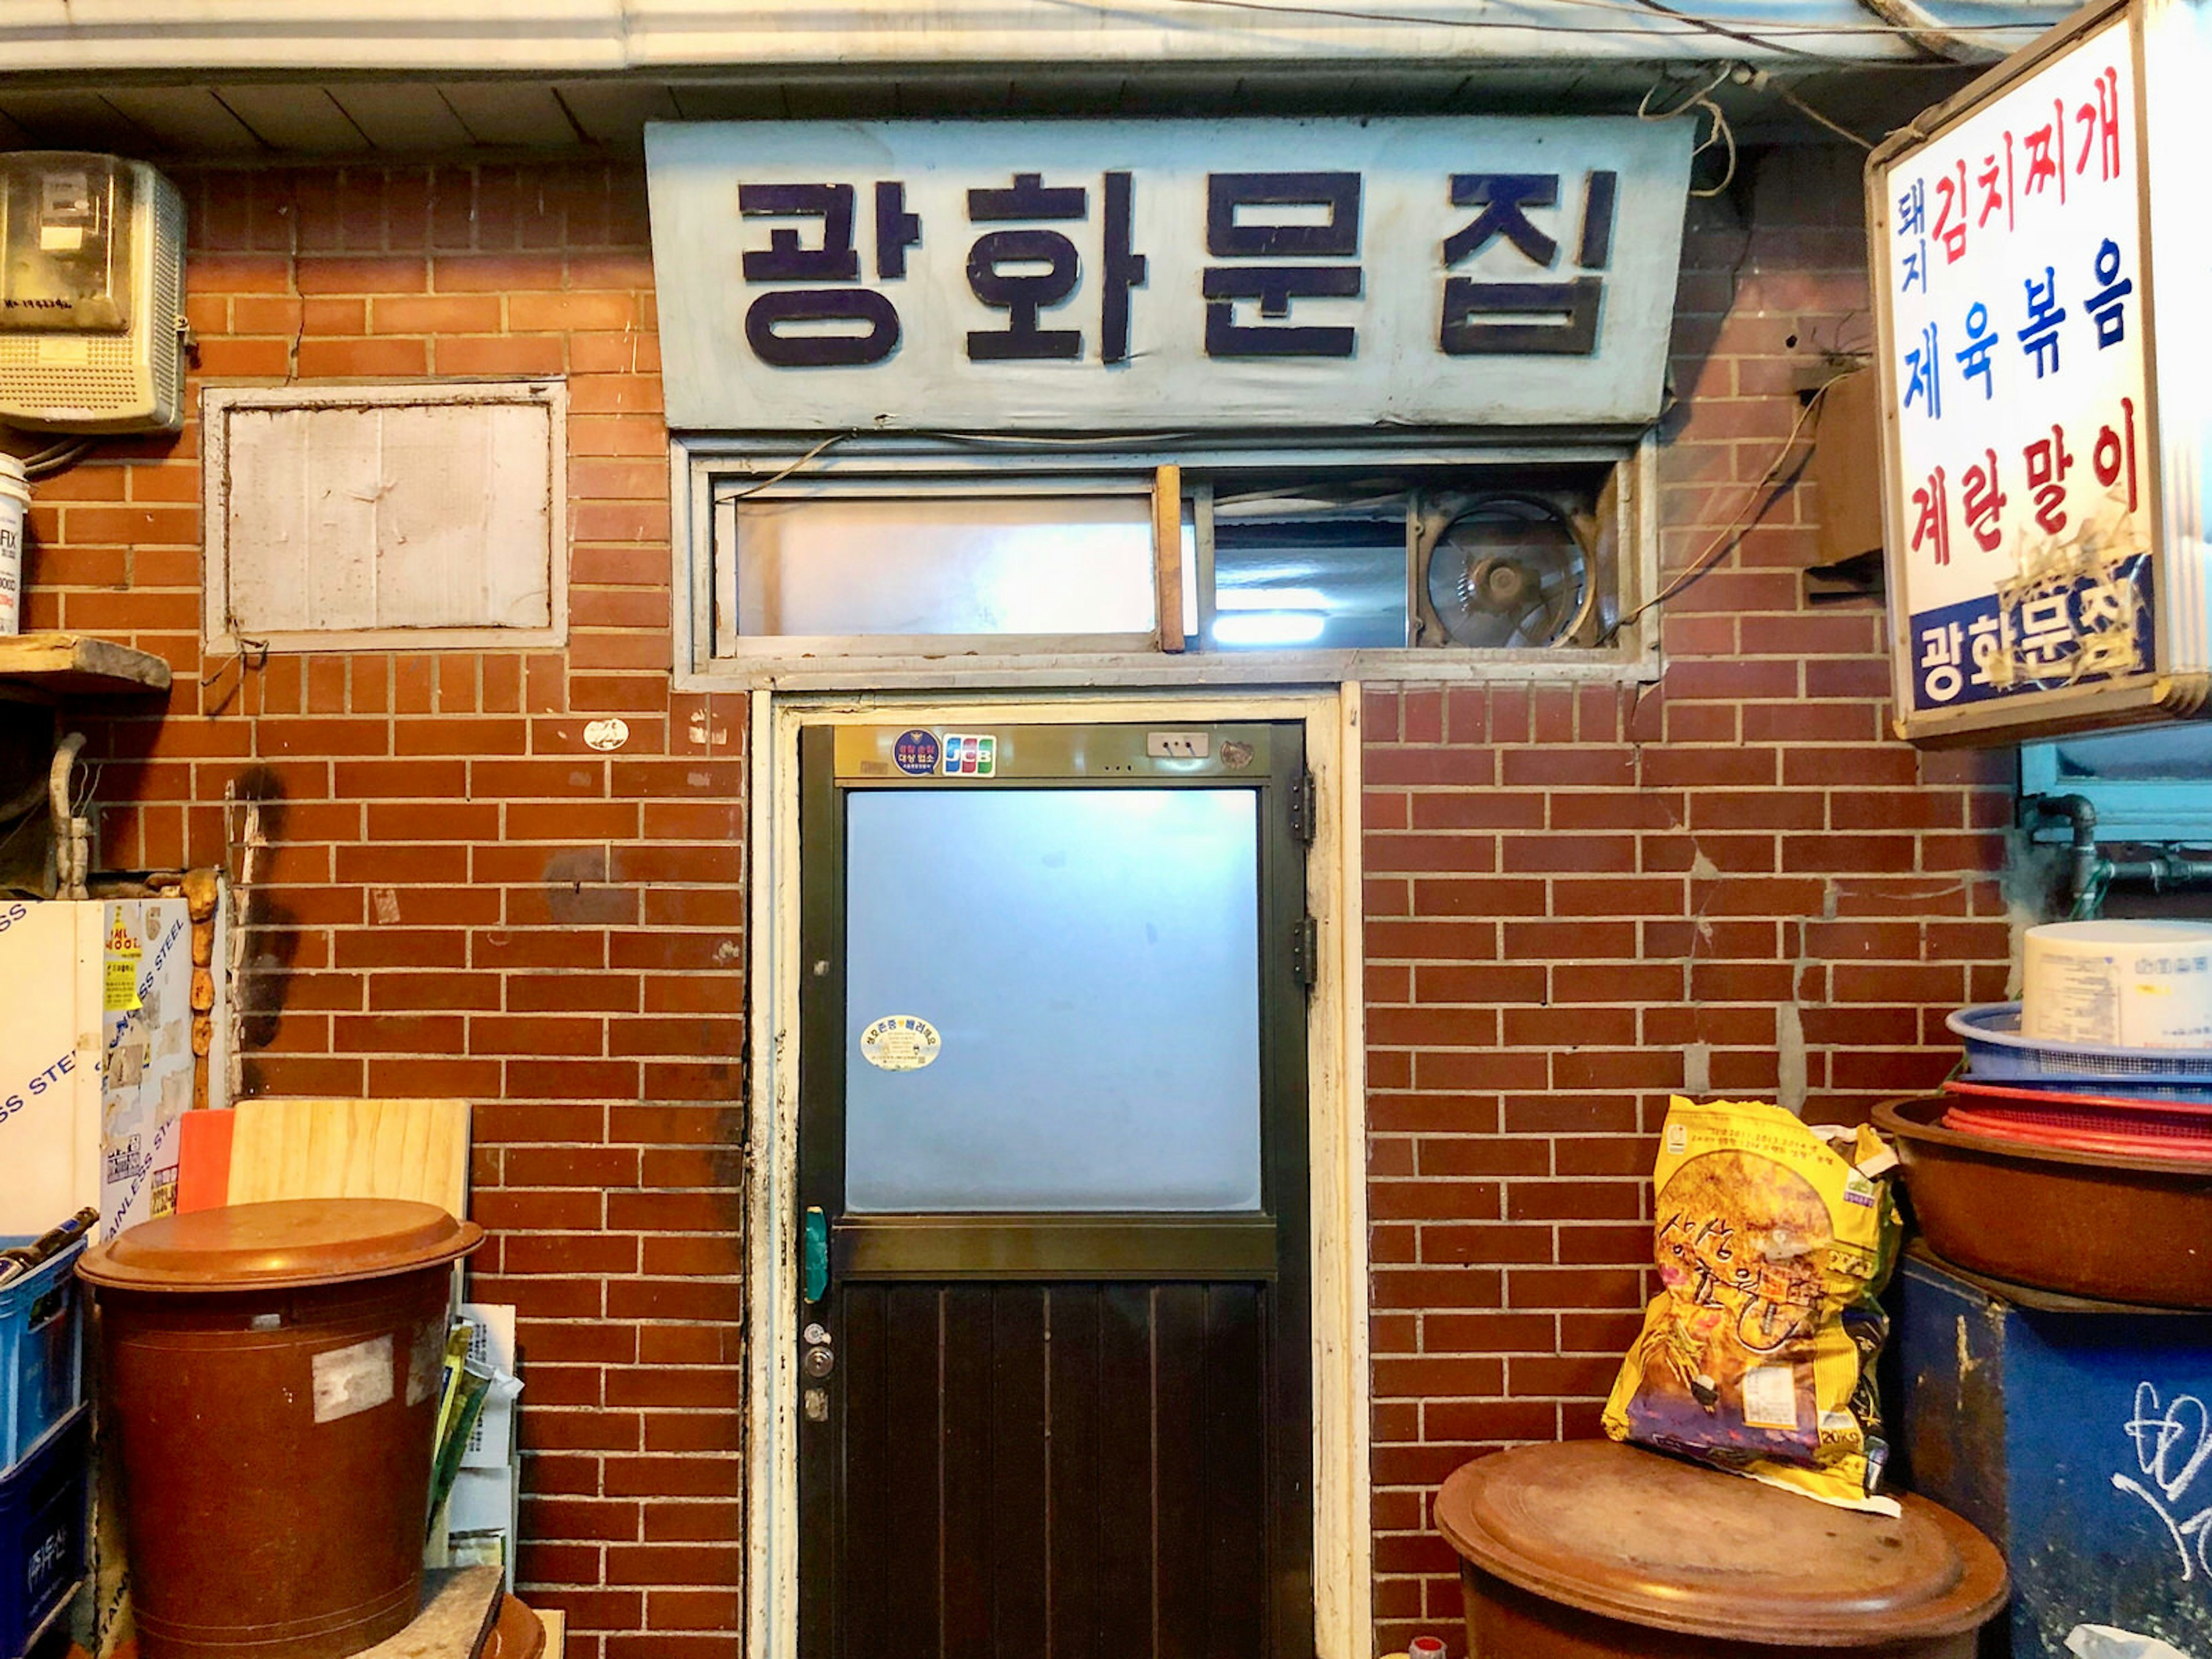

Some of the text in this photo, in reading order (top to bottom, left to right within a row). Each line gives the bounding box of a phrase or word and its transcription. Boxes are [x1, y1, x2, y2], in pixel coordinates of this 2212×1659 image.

[1897, 177, 1927, 294] 돼지
[1931, 66, 2120, 266] 김치찌개
[737, 169, 1616, 367] 광화문집
[1903, 237, 2133, 420] 제육볶음
[1911, 396, 2138, 566] 계란말이
[1920, 576, 2137, 703] 광화문집
[946, 749, 991, 763] JCB
[154, 918, 184, 971] STEEL
